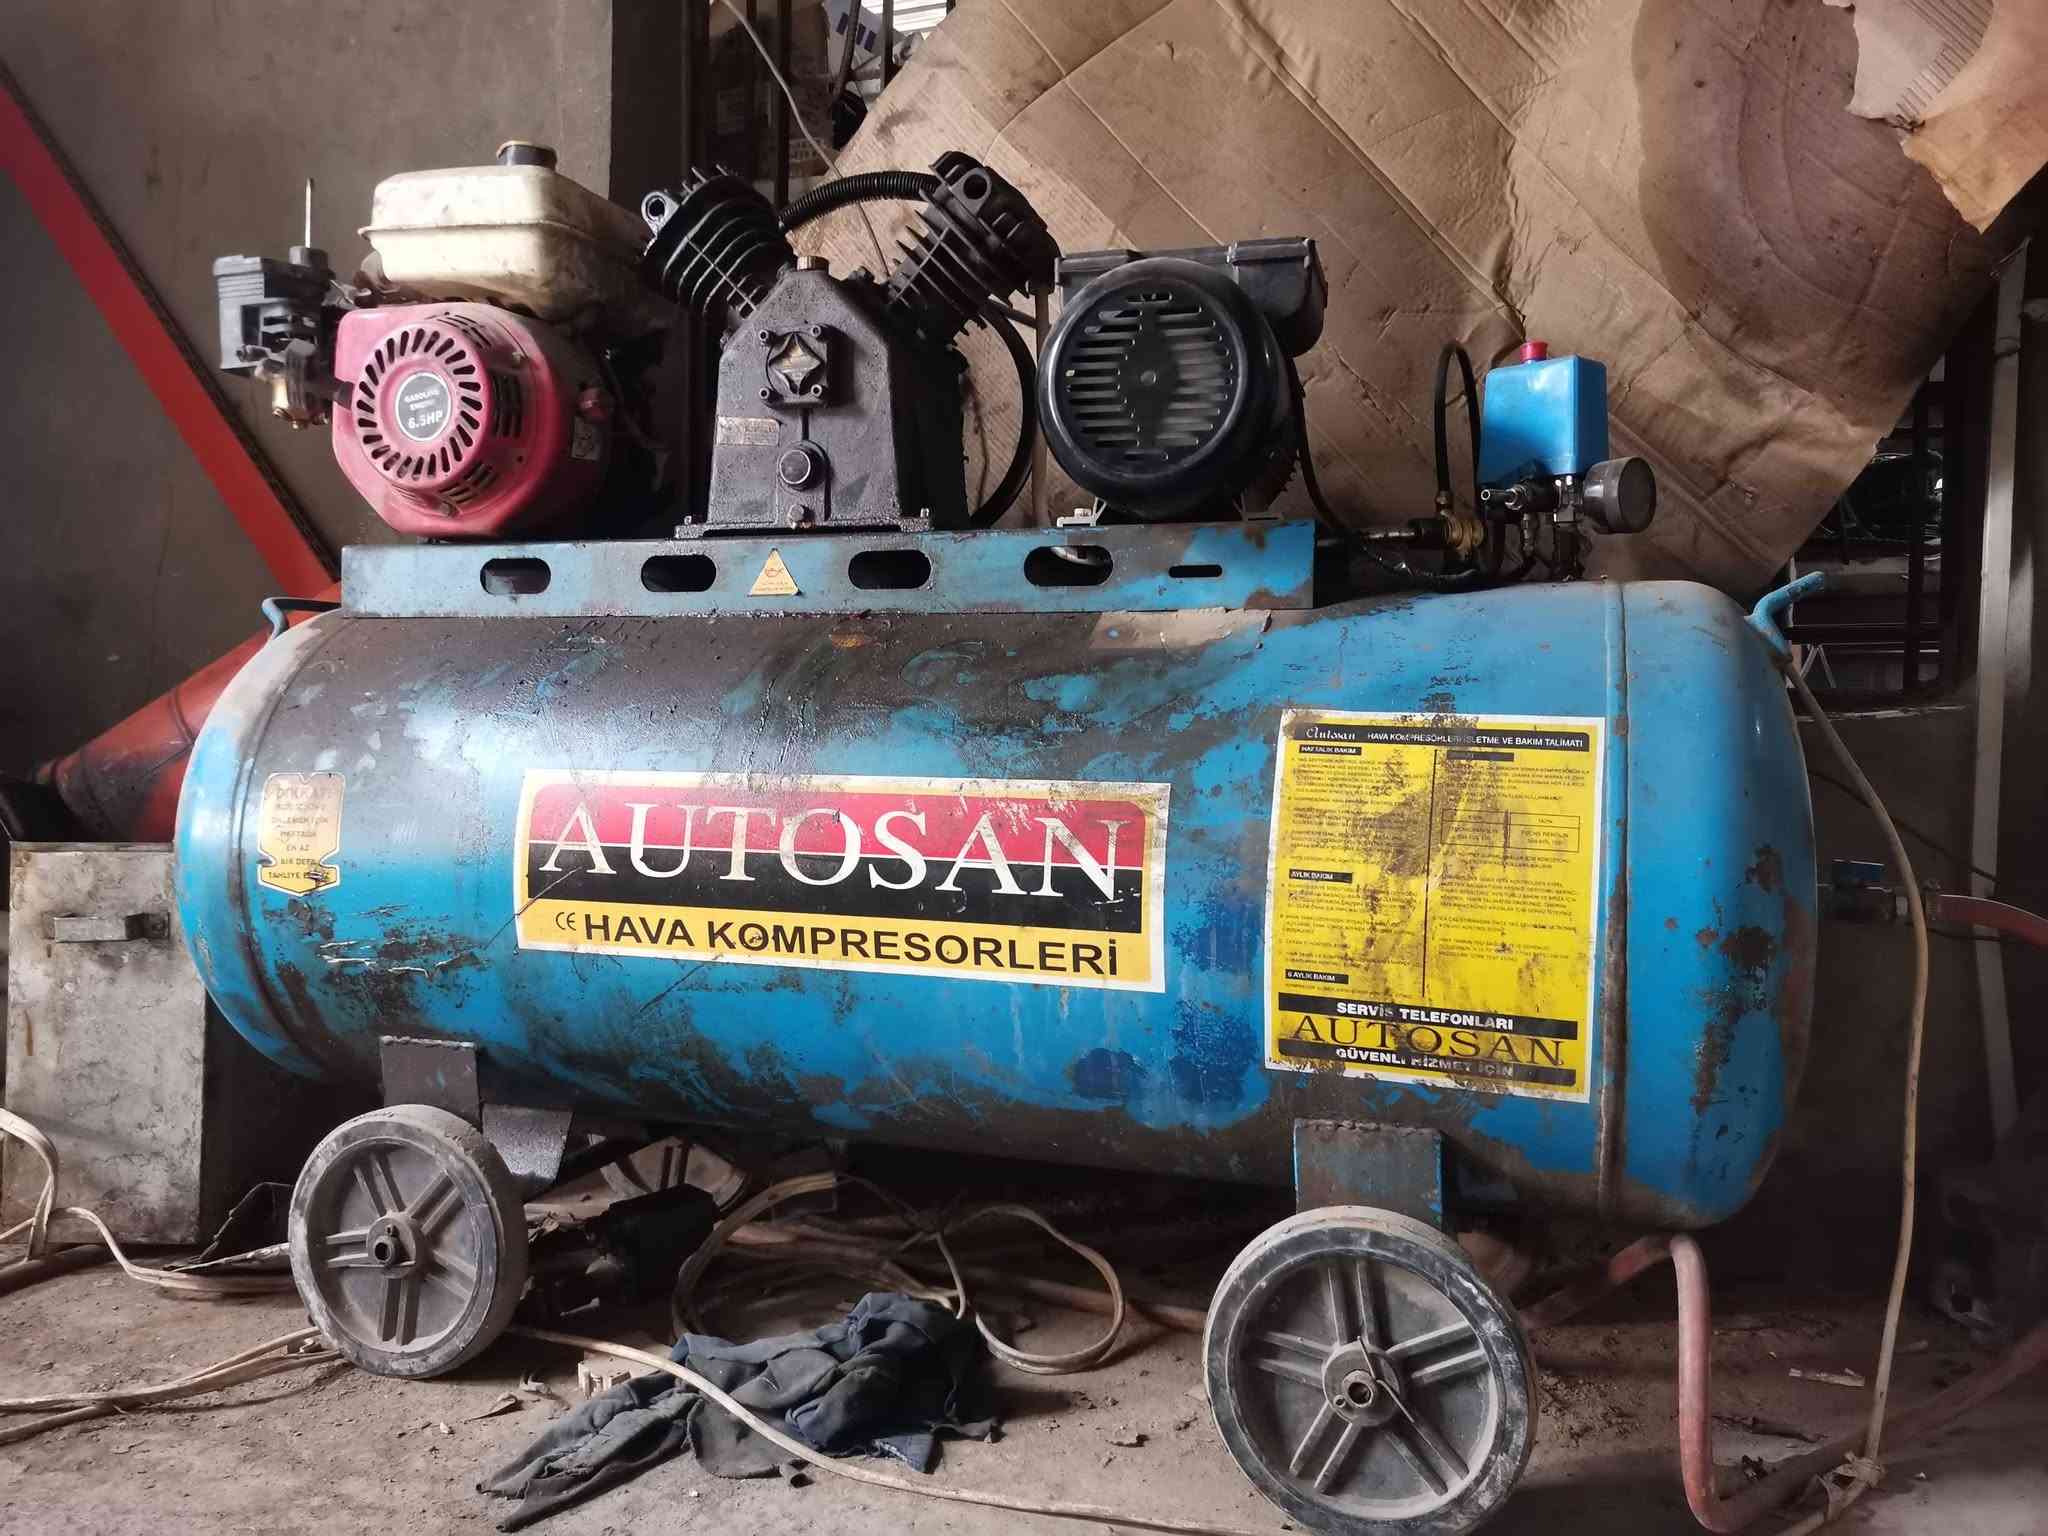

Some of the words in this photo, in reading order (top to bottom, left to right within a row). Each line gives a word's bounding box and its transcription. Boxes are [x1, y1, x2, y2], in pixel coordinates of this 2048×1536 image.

[407, 409, 443, 429] 6.5HP
[1367, 732, 1389, 741] HAVA
[1502, 736, 1513, 745] VE
[1515, 736, 1543, 746] BAKIM
[1544, 737, 1583, 748] TALİMATI
[538, 800, 1133, 902] AUTOSAN
[584, 911, 702, 948] HAVA
[706, 919, 1119, 976] KOMPRESORLERİ
[1399, 1008, 1513, 1030] TELEFONLARI
[1293, 1015, 1564, 1066] AUTOSAN
